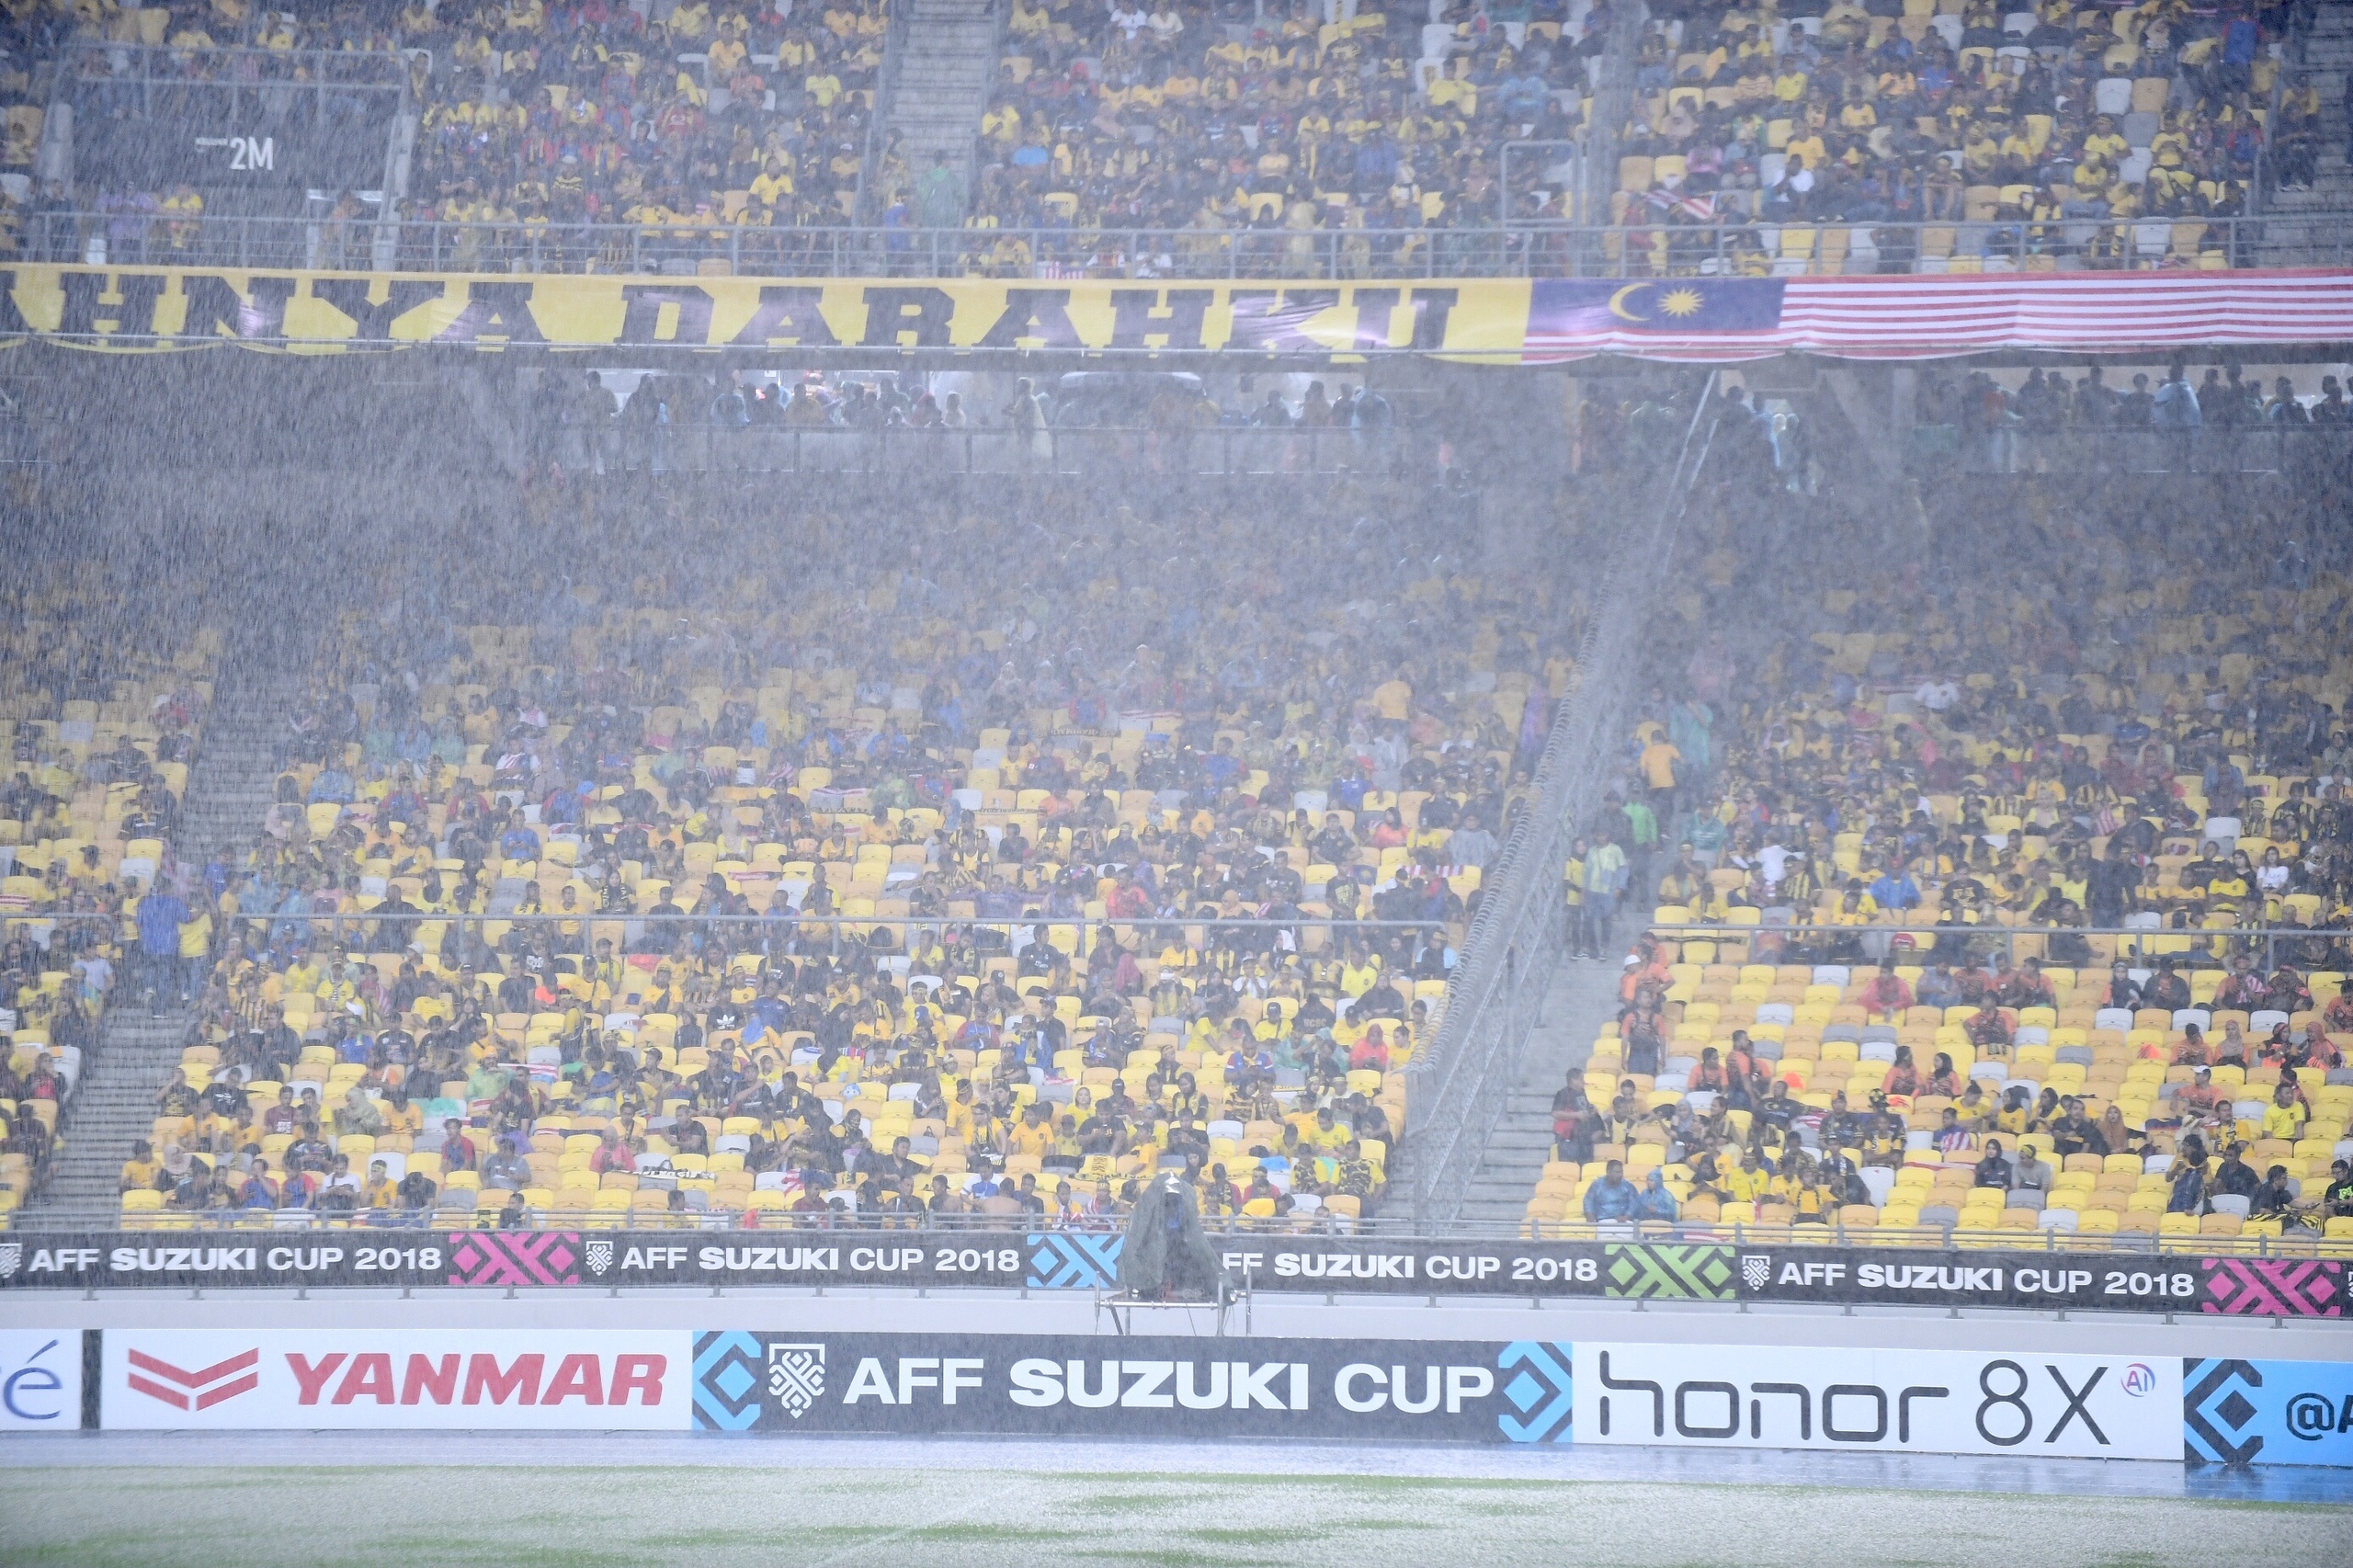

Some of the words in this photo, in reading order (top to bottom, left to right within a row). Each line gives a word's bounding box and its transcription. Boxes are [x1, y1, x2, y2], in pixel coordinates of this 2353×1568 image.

[230, 136, 273, 170] 2M
[0, 270, 551, 350] HNYA
[29, 1249, 99, 1272] AFF
[110, 1247, 256, 1271] SUZUKI
[267, 1247, 343, 1271] CUP
[354, 1247, 442, 1270] 2018
[620, 1246, 688, 1270] AFF
[699, 1246, 839, 1271] SUZUKI
[849, 1247, 925, 1272] CUP
[935, 1248, 1020, 1272] 2018
[1222, 1252, 1263, 1276] FF
[1274, 1252, 1415, 1278] SUZUKI
[1425, 1255, 1501, 1279] CUP
[1511, 1256, 1598, 1282] 2018
[1778, 1262, 1847, 1286] AFF
[1857, 1263, 2003, 1291] SUZUKI
[2014, 1268, 2093, 1293] CUP
[2104, 1271, 2195, 1297] 2018
[285, 1352, 667, 1406] YANMAR
[842, 1357, 984, 1405] AFF
[1008, 1358, 1309, 1411] SUZUKI
[1334, 1362, 1495, 1414] CUP
[1599, 1350, 1950, 1444] honor
[1974, 1358, 2112, 1447] 8X
